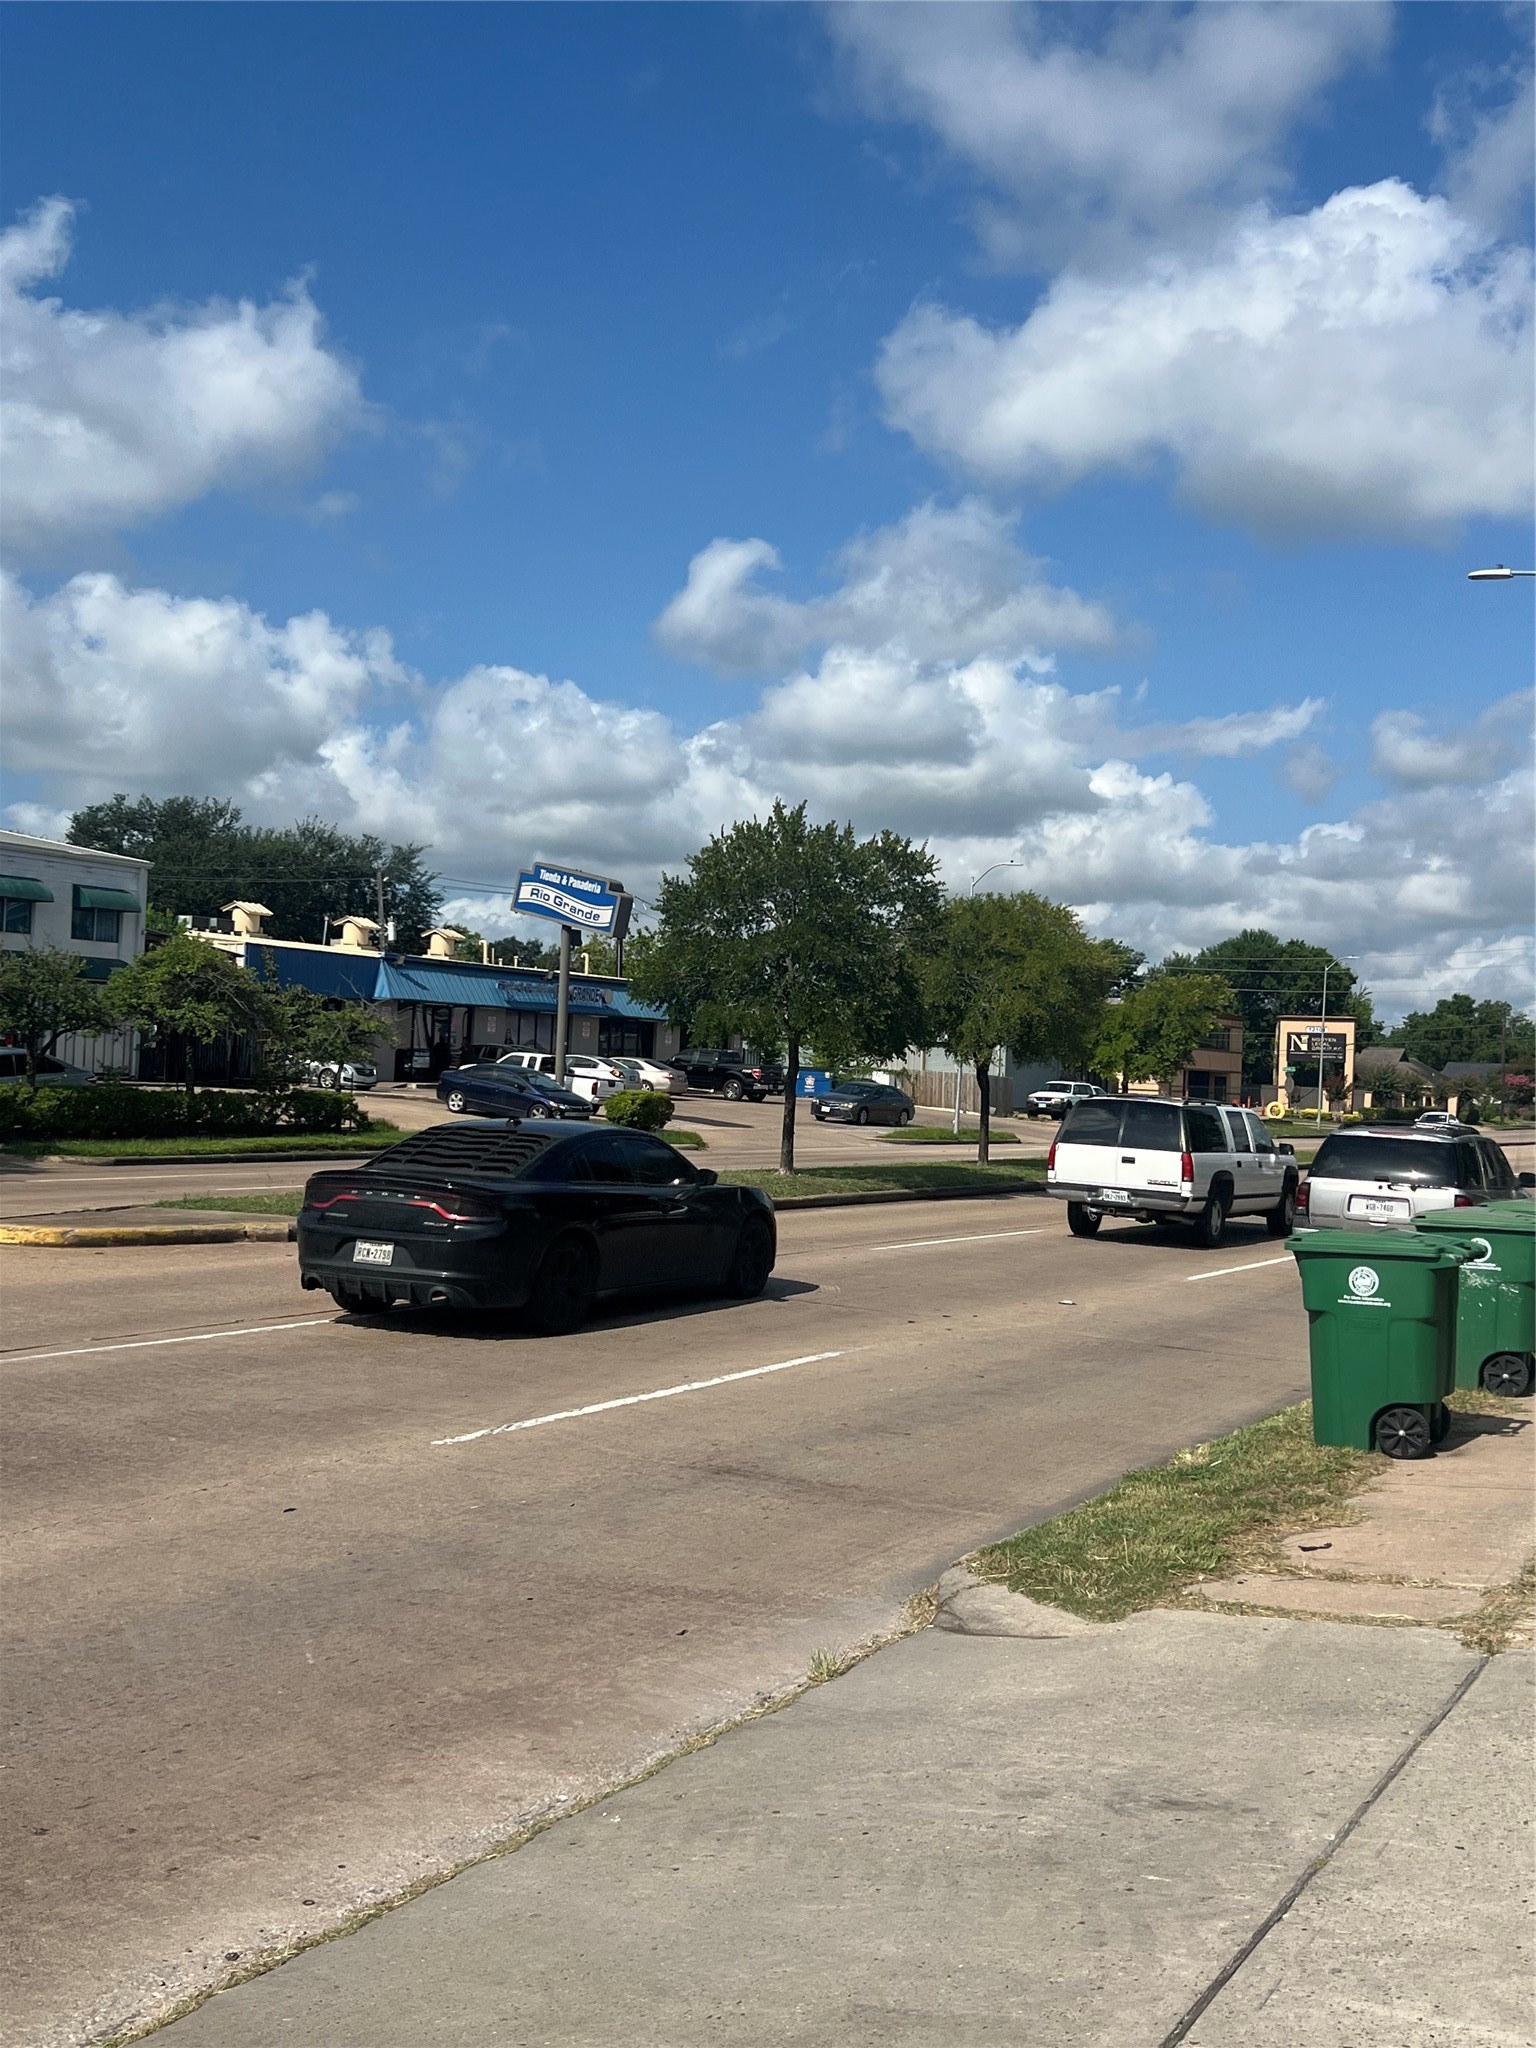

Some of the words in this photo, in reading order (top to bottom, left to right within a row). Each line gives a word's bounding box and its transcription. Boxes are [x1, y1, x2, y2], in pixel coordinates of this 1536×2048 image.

[540, 869, 560, 884] Tienda
[561, 874, 568, 886] &
[553, 895, 601, 921] Grande
